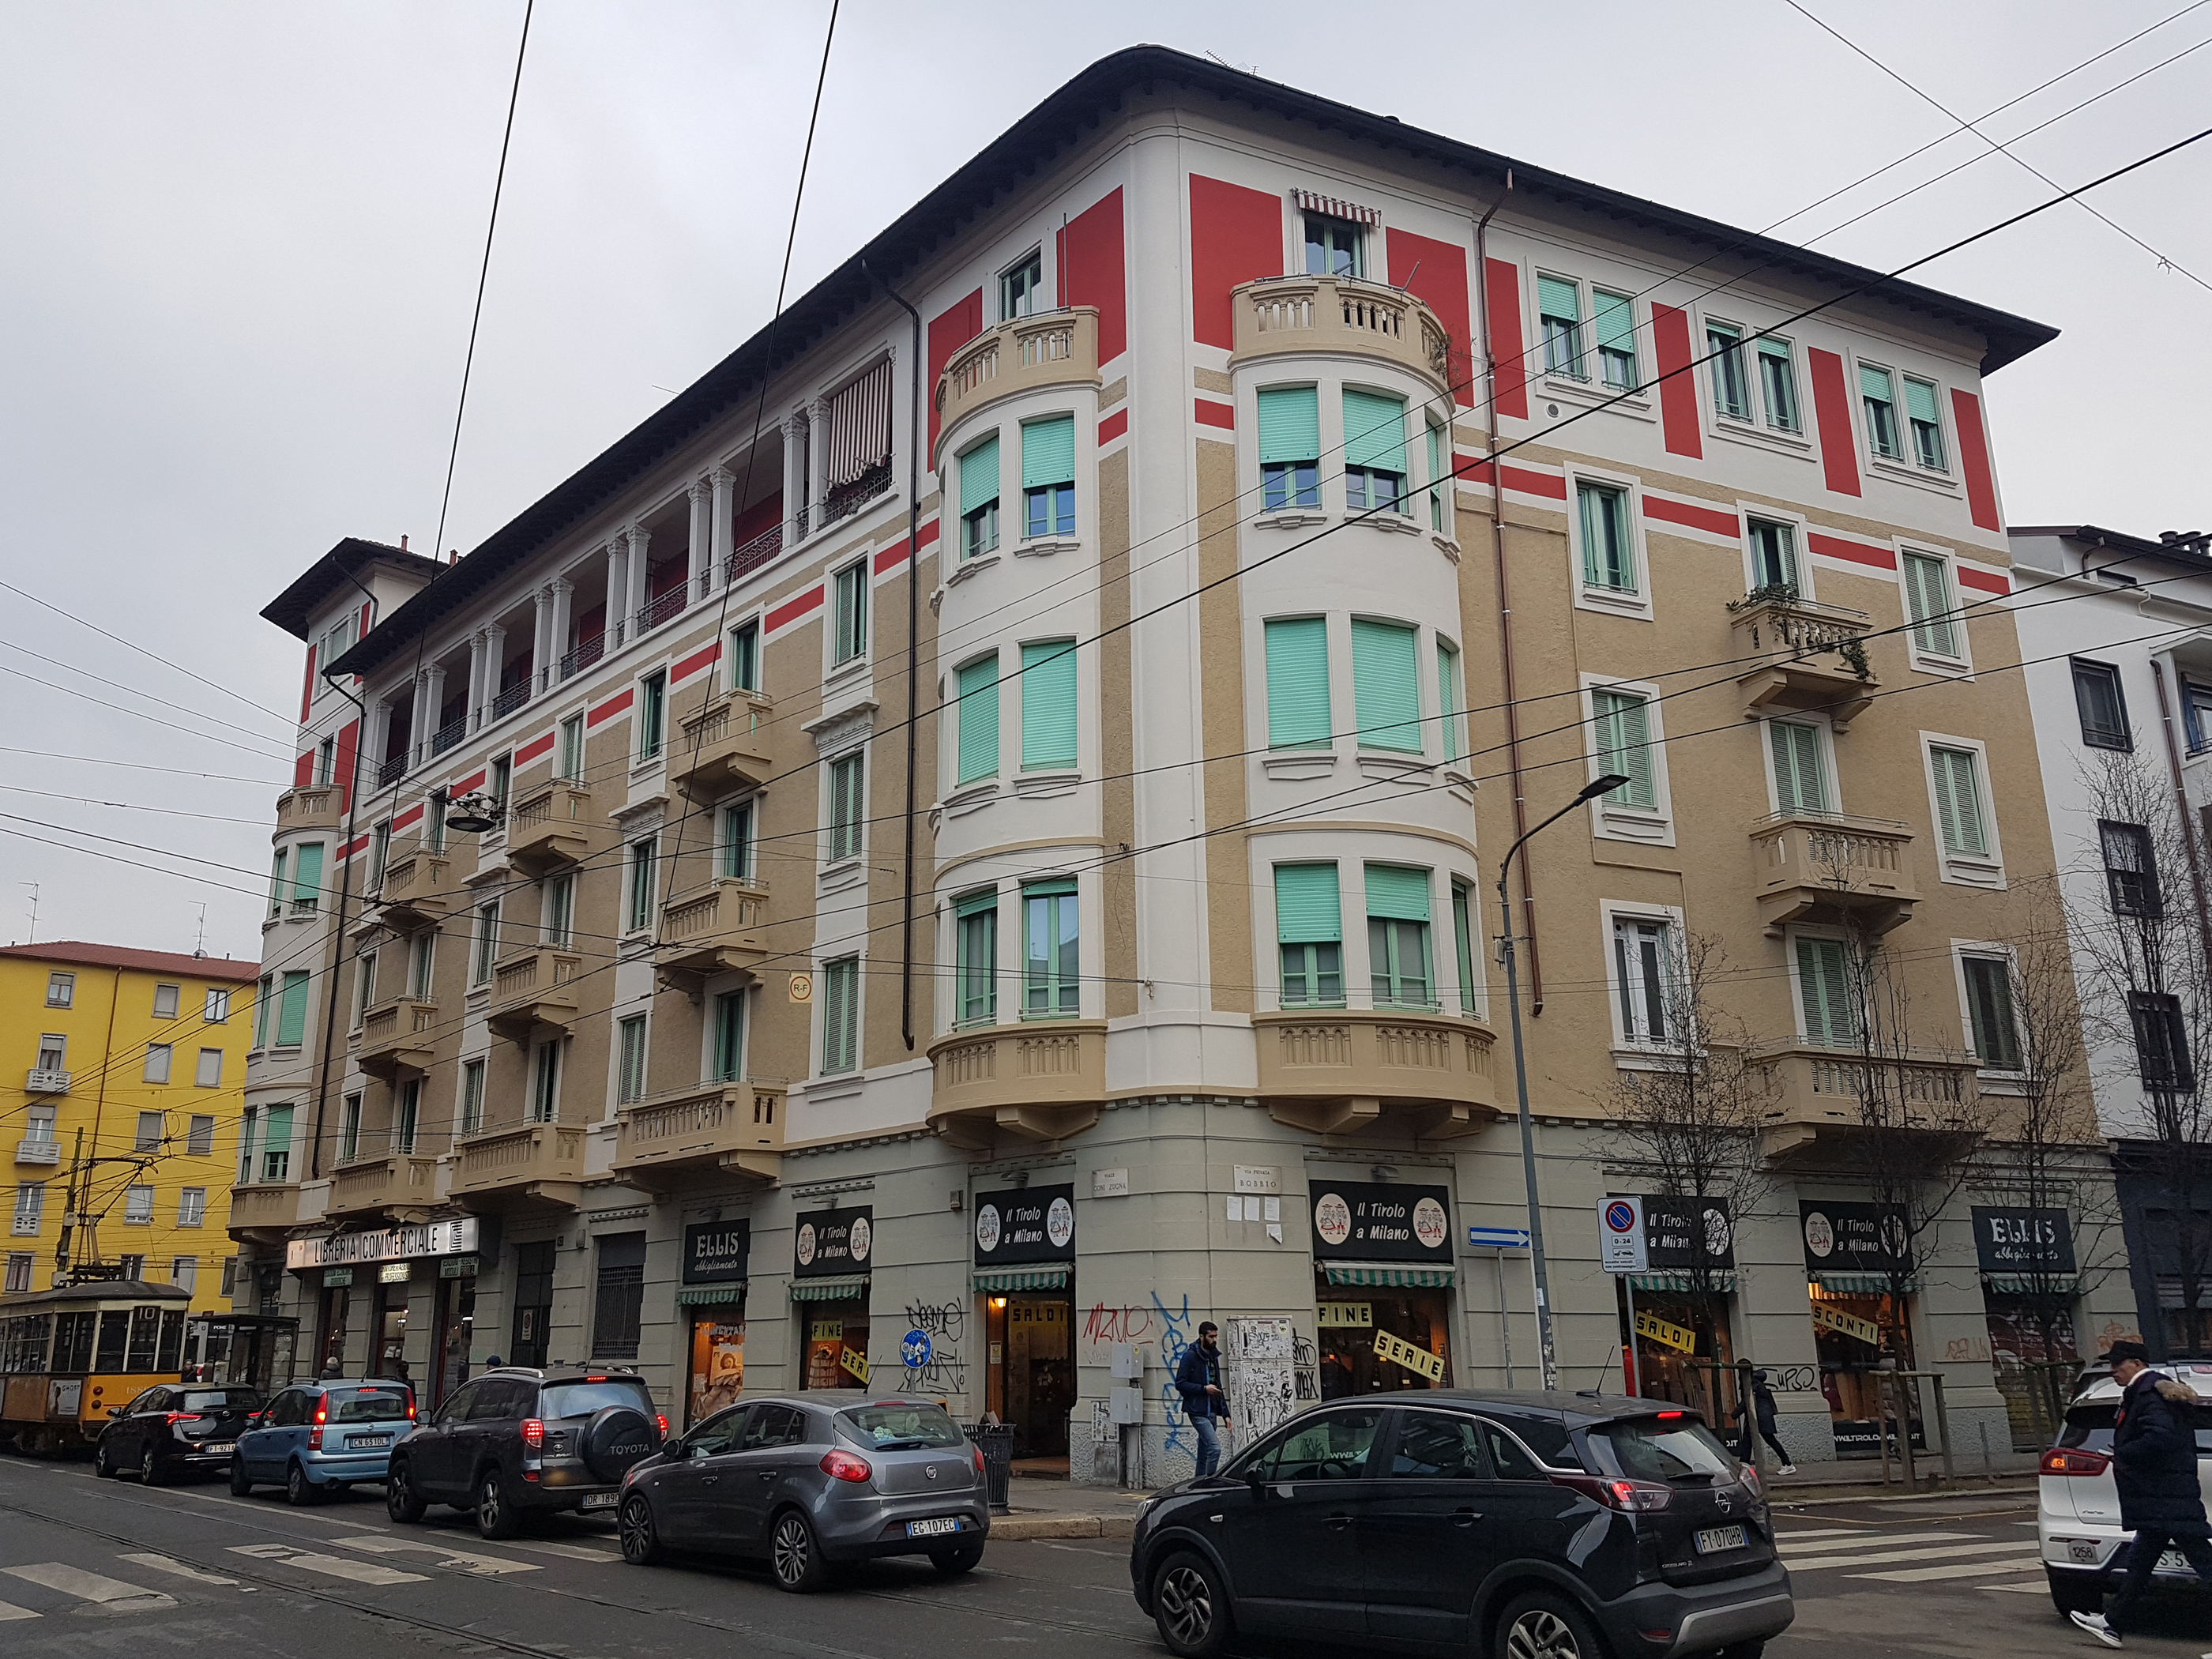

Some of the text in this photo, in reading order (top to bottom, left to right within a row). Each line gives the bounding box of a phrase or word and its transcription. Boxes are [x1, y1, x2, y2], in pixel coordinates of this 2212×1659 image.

[1006, 1206, 1041, 1223] Il Tirolo
[1357, 1202, 1406, 1218] Il Tirolo
[1650, 1213, 1657, 1227] Il
[1837, 1218, 1875, 1232] Il Tirolo
[819, 1225, 847, 1240] Il Tirolo
[1004, 1228, 1043, 1243] a Milano
[1356, 1224, 1409, 1241] a Milano
[314, 1236, 356, 1263] LIBRERIA
[363, 1227, 438, 1259] COMMERCIALE
[695, 1232, 739, 1258] ELLIS
[1650, 1236, 1657, 1247] a
[1838, 1238, 1879, 1252] a Milano
[818, 1244, 848, 1258] a Milano
[694, 1258, 738, 1274] abbigliamento
[138, 1306, 156, 1321] 10
[1013, 1308, 1063, 1322] SALDI
[1319, 1307, 1369, 1322] FINE
[1814, 1306, 1874, 1339] SCONTI
[813, 1324, 841, 1337] FINE
[1636, 1316, 1691, 1348] SALDI
[1377, 1335, 1440, 1376] SERIE
[609, 1443, 650, 1455] TOYOTA
[2072, 1547, 2093, 1558] 1258
